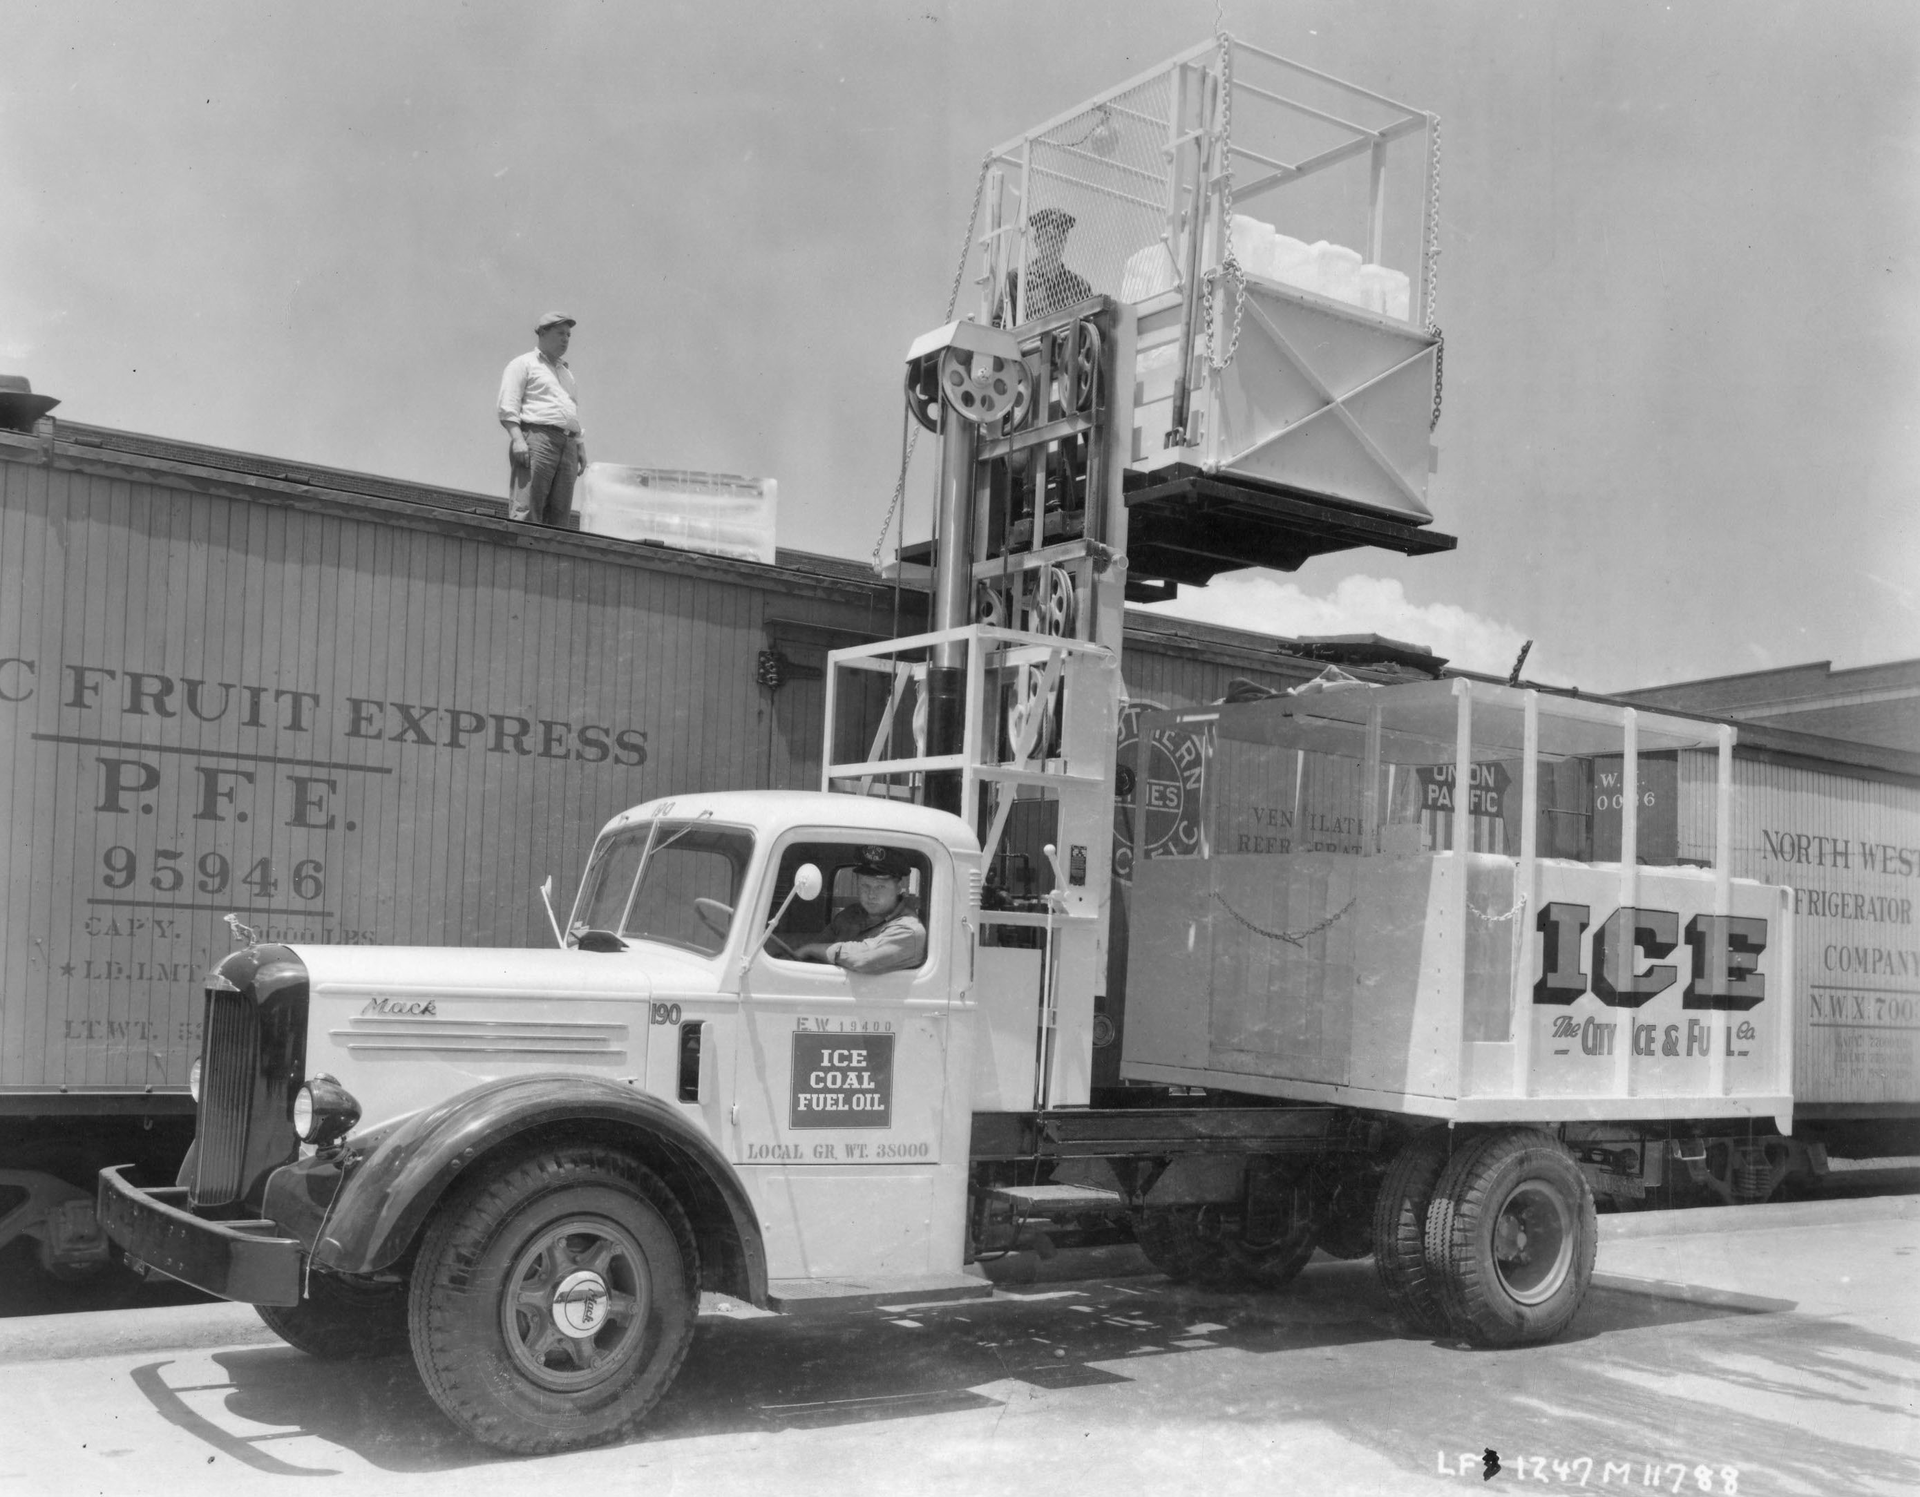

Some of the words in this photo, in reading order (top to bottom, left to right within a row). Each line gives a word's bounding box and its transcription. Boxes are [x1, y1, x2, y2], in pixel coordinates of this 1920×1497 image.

[64, 664, 320, 732] FRUIT
[344, 697, 648, 766] EXPRESS
[1433, 764, 1495, 788] UNON
[1428, 784, 1498, 813] PAFIC
[1762, 829, 1851, 869] NORTH
[102, 845, 324, 900] 95946
[1532, 901, 1768, 1011] ICE
[361, 998, 437, 1015] Mack
[651, 1003, 681, 1025] 190
[1552, 1015, 1581, 1038] The
[1662, 1024, 1680, 1057] &
[1686, 1018, 1735, 1057] FUL
[820, 1049, 867, 1067] ICE
[809, 1071, 875, 1089] COAL
[797, 1093, 849, 1111] FUEL
[852, 1093, 885, 1111] OIL
[747, 1144, 804, 1160] LOCAL
[845, 1144, 870, 1159] WT.
[582, 1287, 597, 1324] Mack
